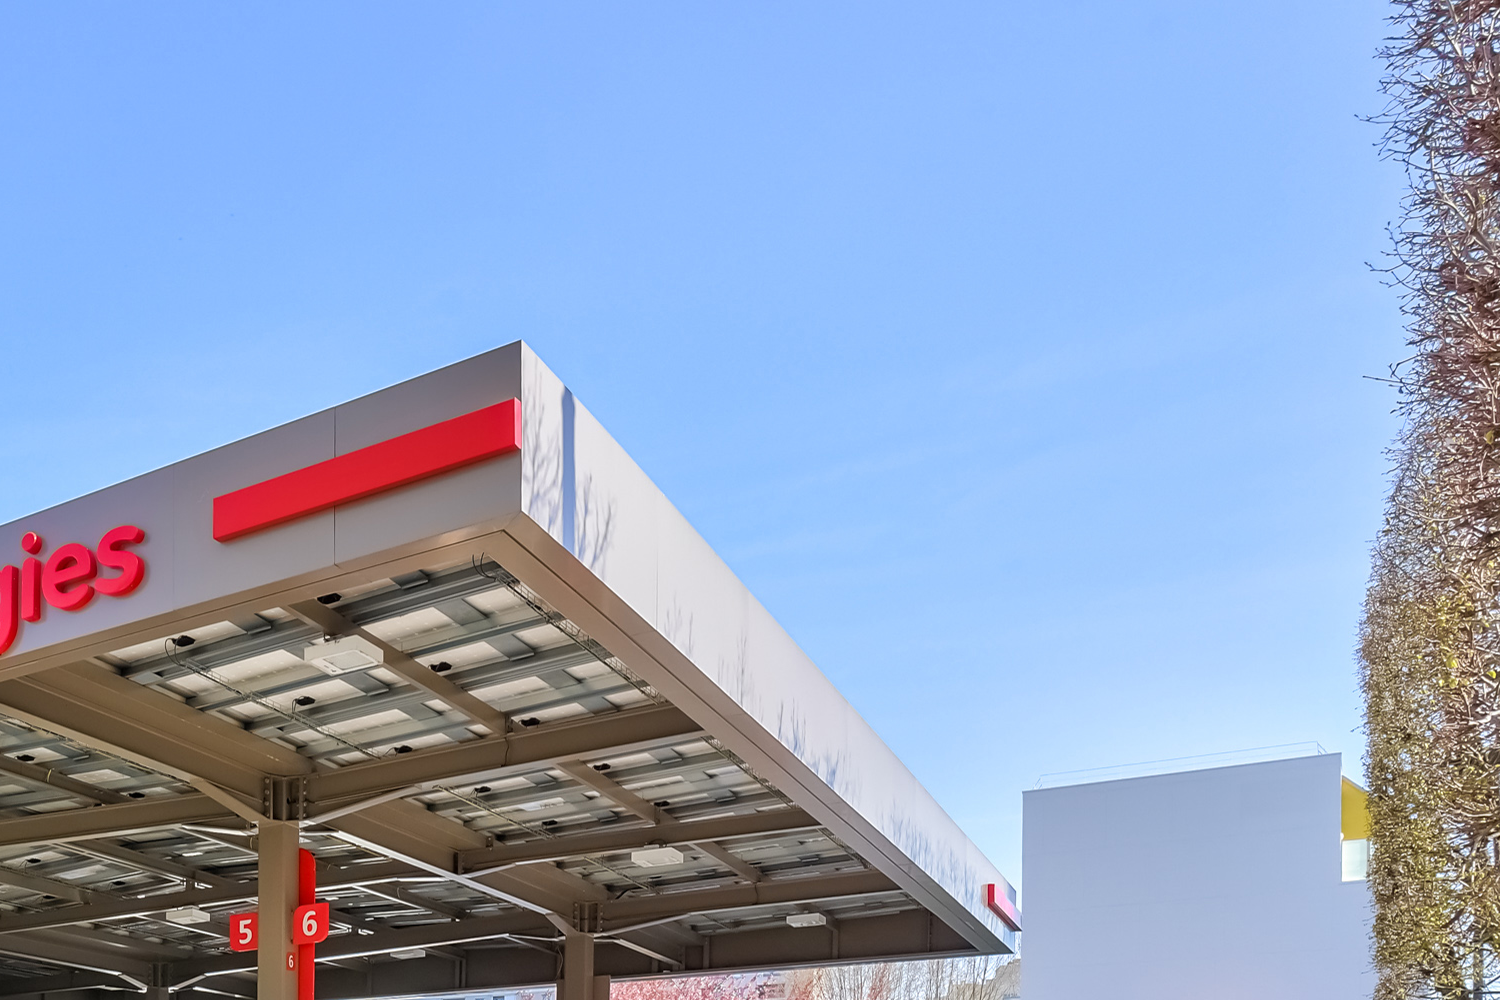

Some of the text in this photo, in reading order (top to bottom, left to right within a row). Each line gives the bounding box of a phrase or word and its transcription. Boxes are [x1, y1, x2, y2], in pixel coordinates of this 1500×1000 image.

[239, 919, 253, 945] 5
[302, 910, 318, 936] 6
[288, 955, 294, 968] 6
